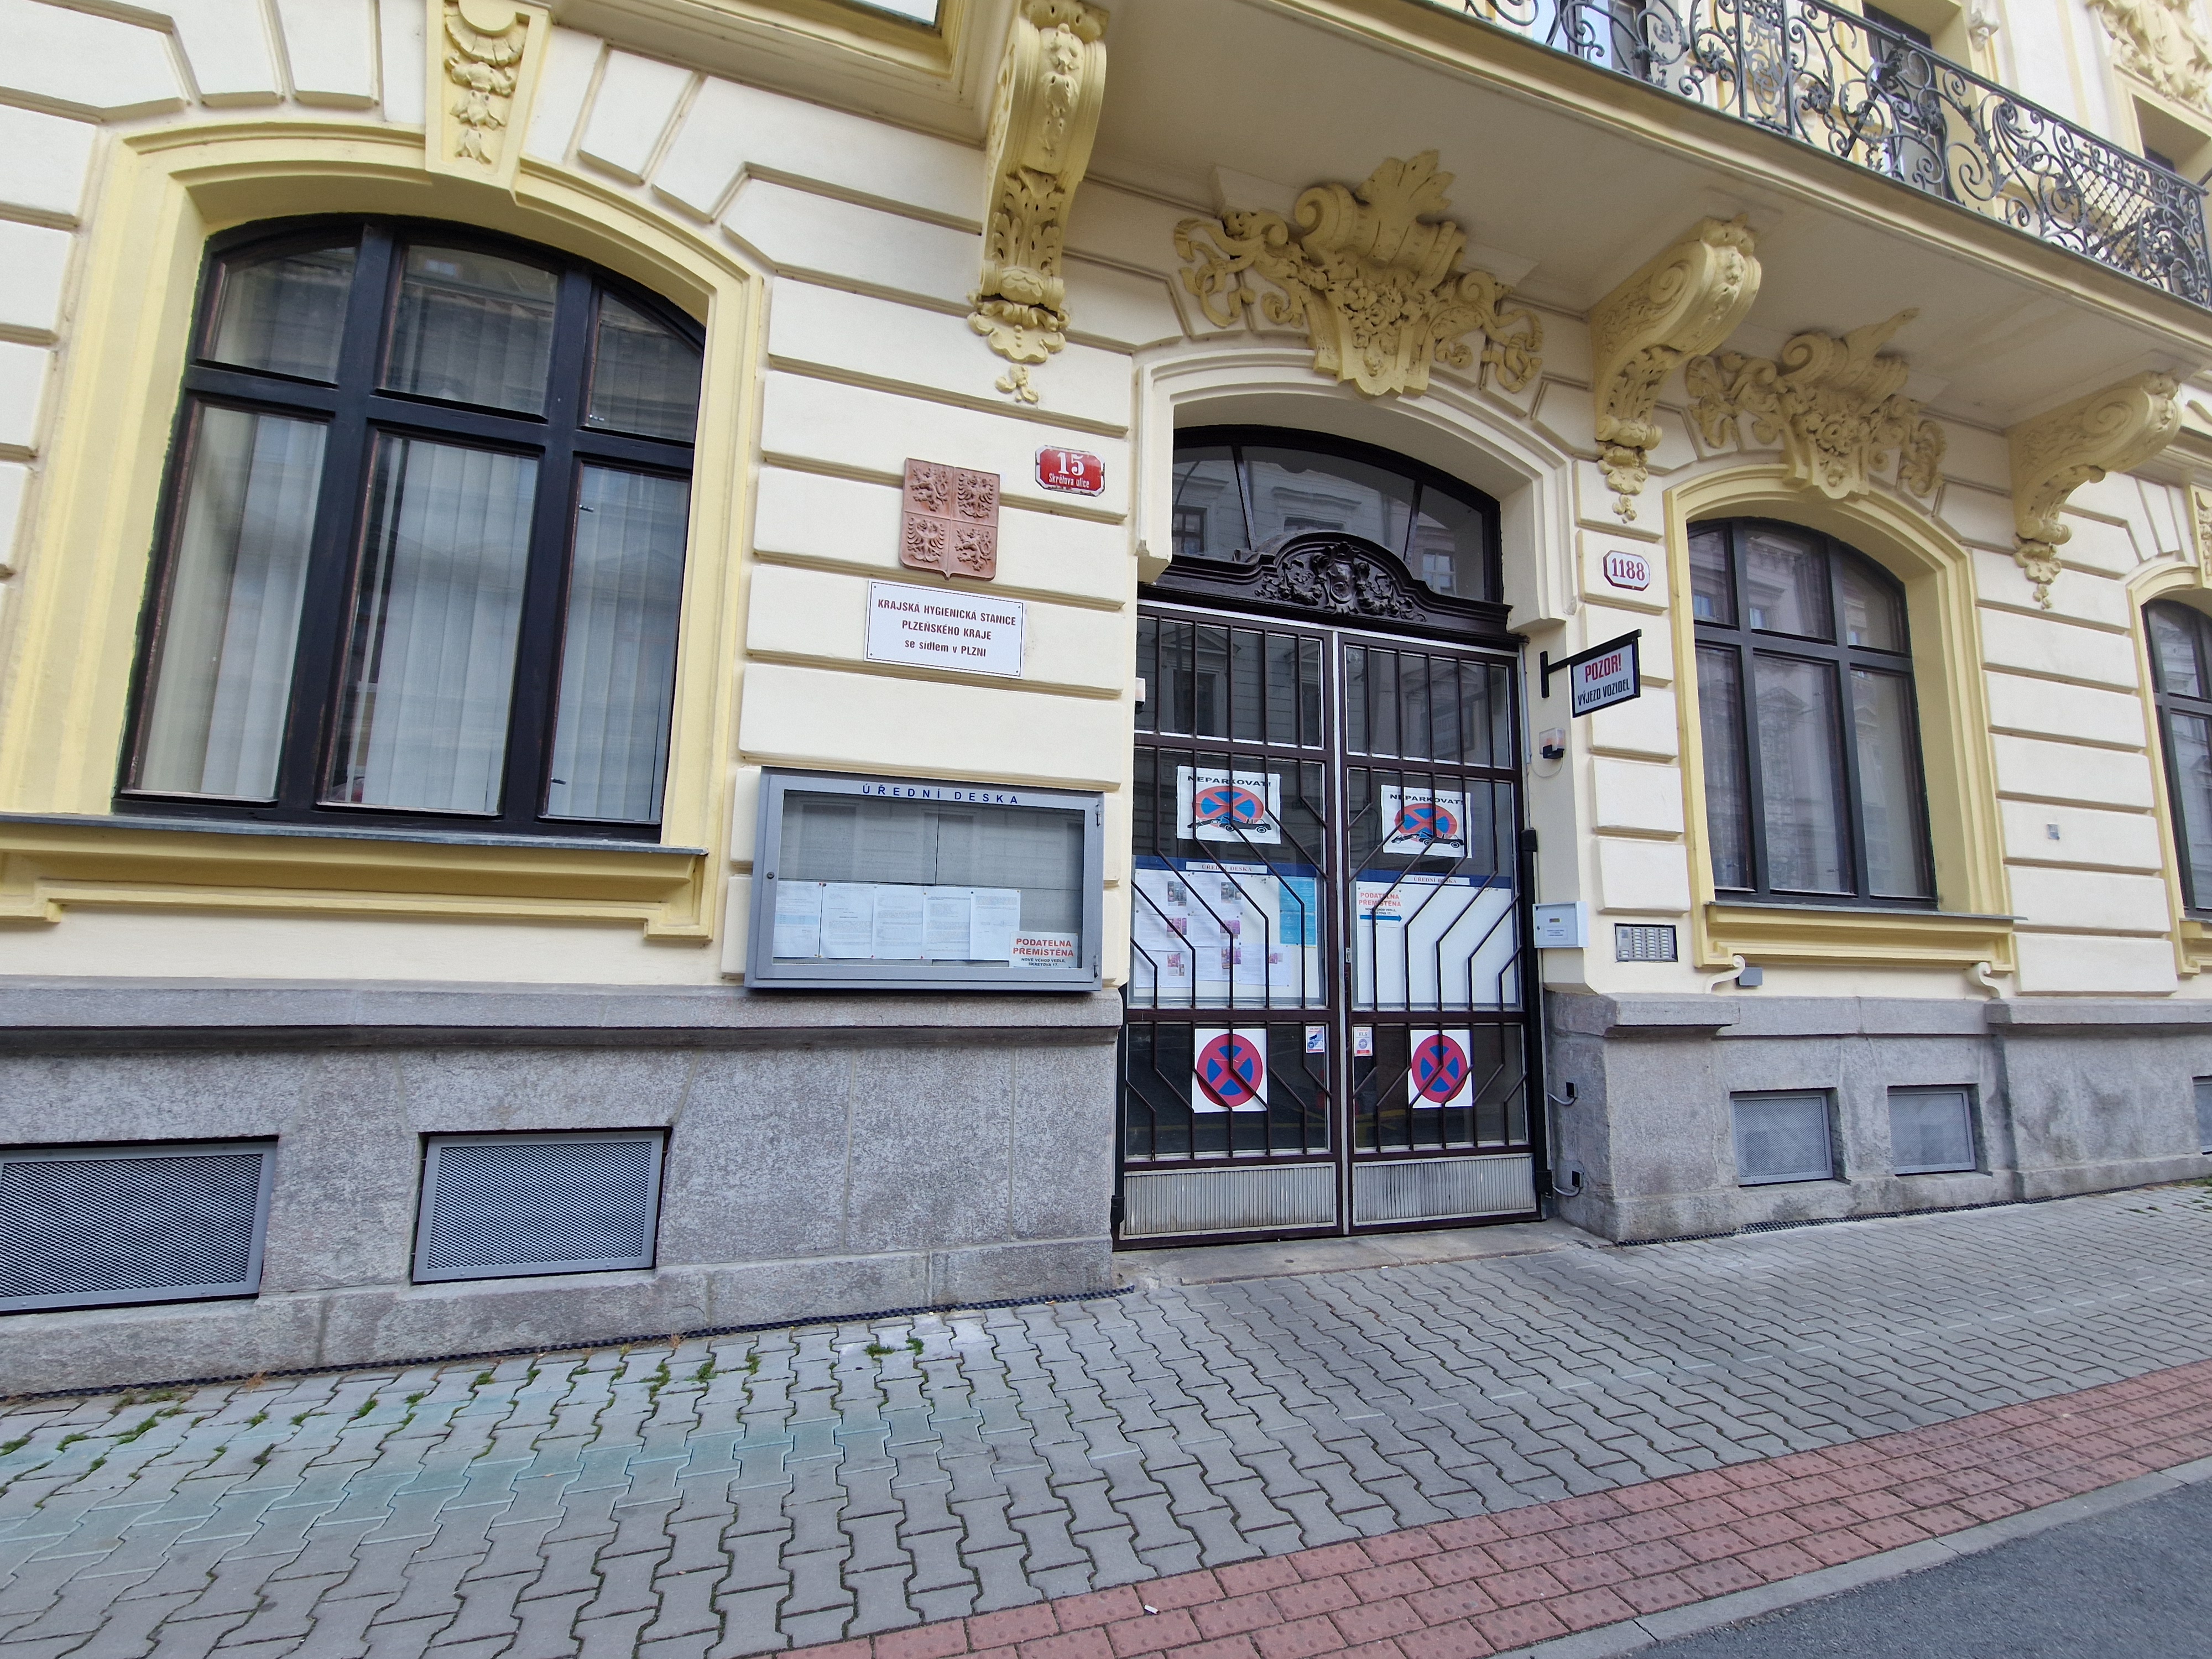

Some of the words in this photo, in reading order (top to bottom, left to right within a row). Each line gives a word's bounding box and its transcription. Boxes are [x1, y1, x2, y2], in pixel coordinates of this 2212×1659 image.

[1057, 452, 1084, 476] 15
[1076, 477, 1089, 488] ulice
[1611, 557, 1645, 581] 1188
[878, 599, 920, 613] KRAJSKÁ
[924, 604, 977, 620] HYGIENICKÁ
[980, 612, 1016, 626] STANICE
[902, 620, 959, 637] PLZEŇSKÉHO
[963, 628, 992, 640] KRAJE
[905, 639, 915, 649] se
[919, 640, 949, 653] sídlem
[961, 645, 987, 658] PLZNI
[1585, 653, 1621, 683] POZOR!
[1578, 690, 1601, 706] VÝJEZD
[1603, 679, 1630, 698] VOZIDEL
[862, 783, 941, 799] ÚŘEDNÍ
[954, 791, 1018, 804] DESKA
[1202, 863, 1228, 872] ÚŘEDÍ
[1013, 946, 1073, 956] PŘEMÍSTĚNA
[1016, 938, 1072, 947] PODATELNA
